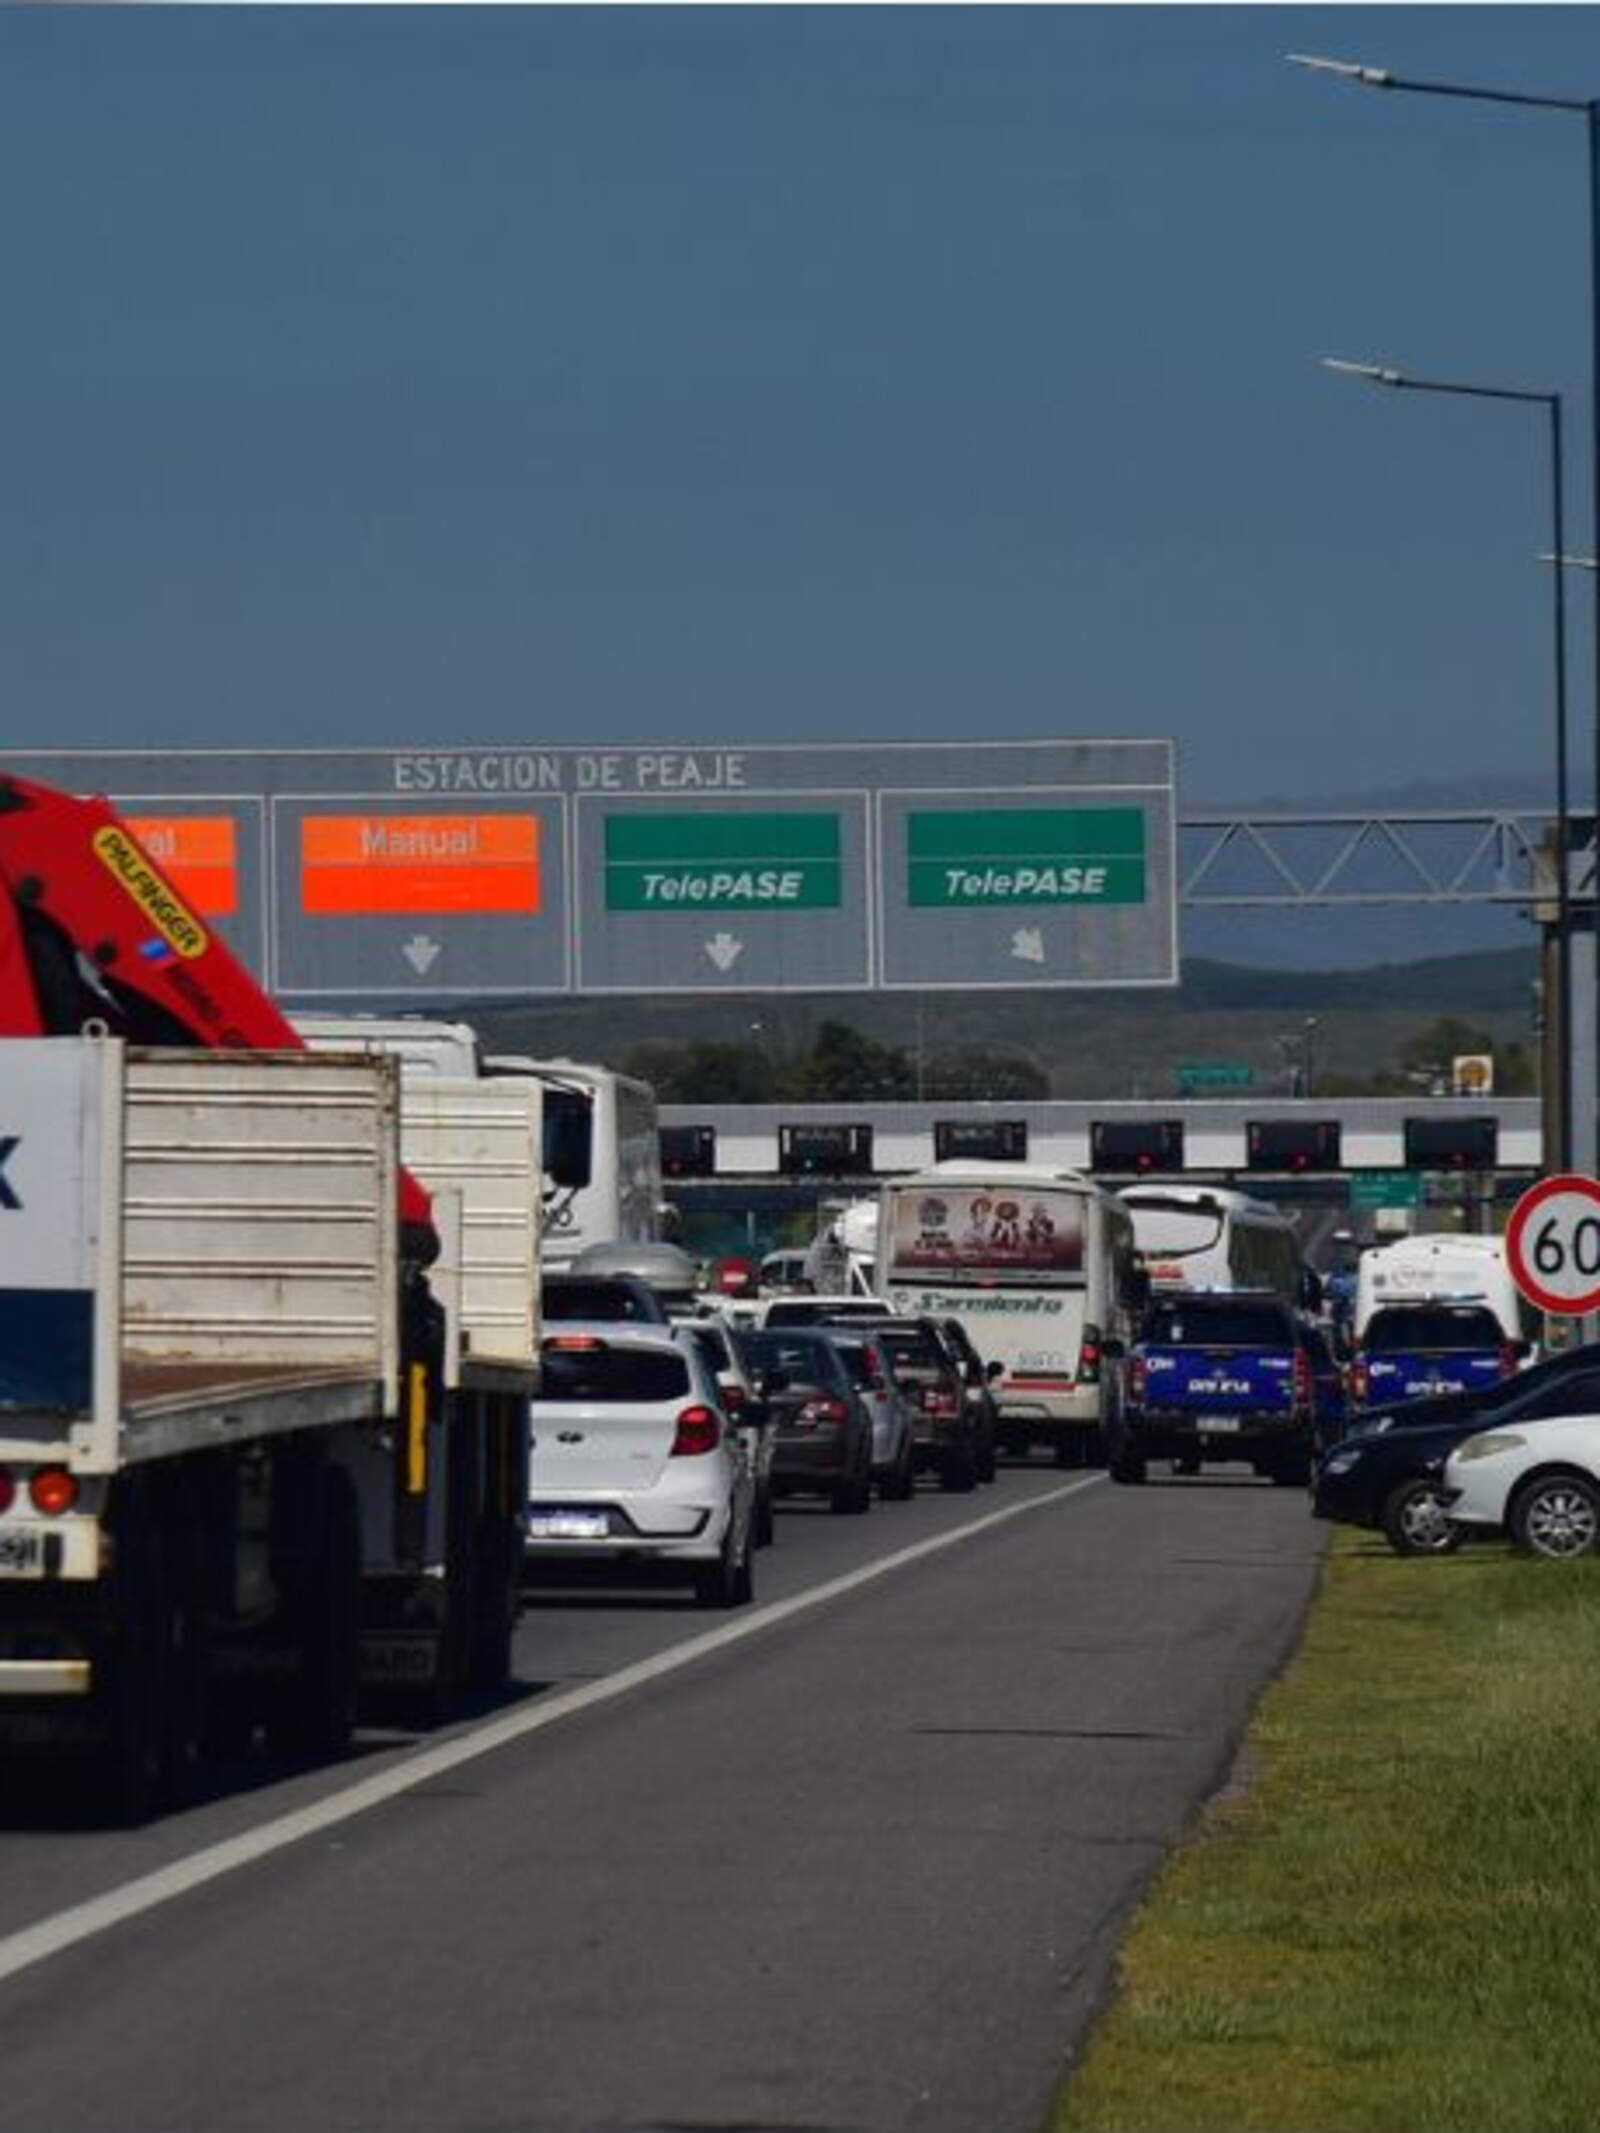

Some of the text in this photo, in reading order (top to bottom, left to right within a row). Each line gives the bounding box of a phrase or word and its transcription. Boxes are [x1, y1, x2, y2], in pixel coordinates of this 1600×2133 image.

[393, 754, 747, 790] ESTACION DE PEAJE
[361, 819, 478, 858] Manual
[99, 831, 200, 951] PALFINGER
[642, 871, 805, 903] TelePASE
[944, 867, 1108, 899] TelePASE
[1533, 1216, 1600, 1276] 60
